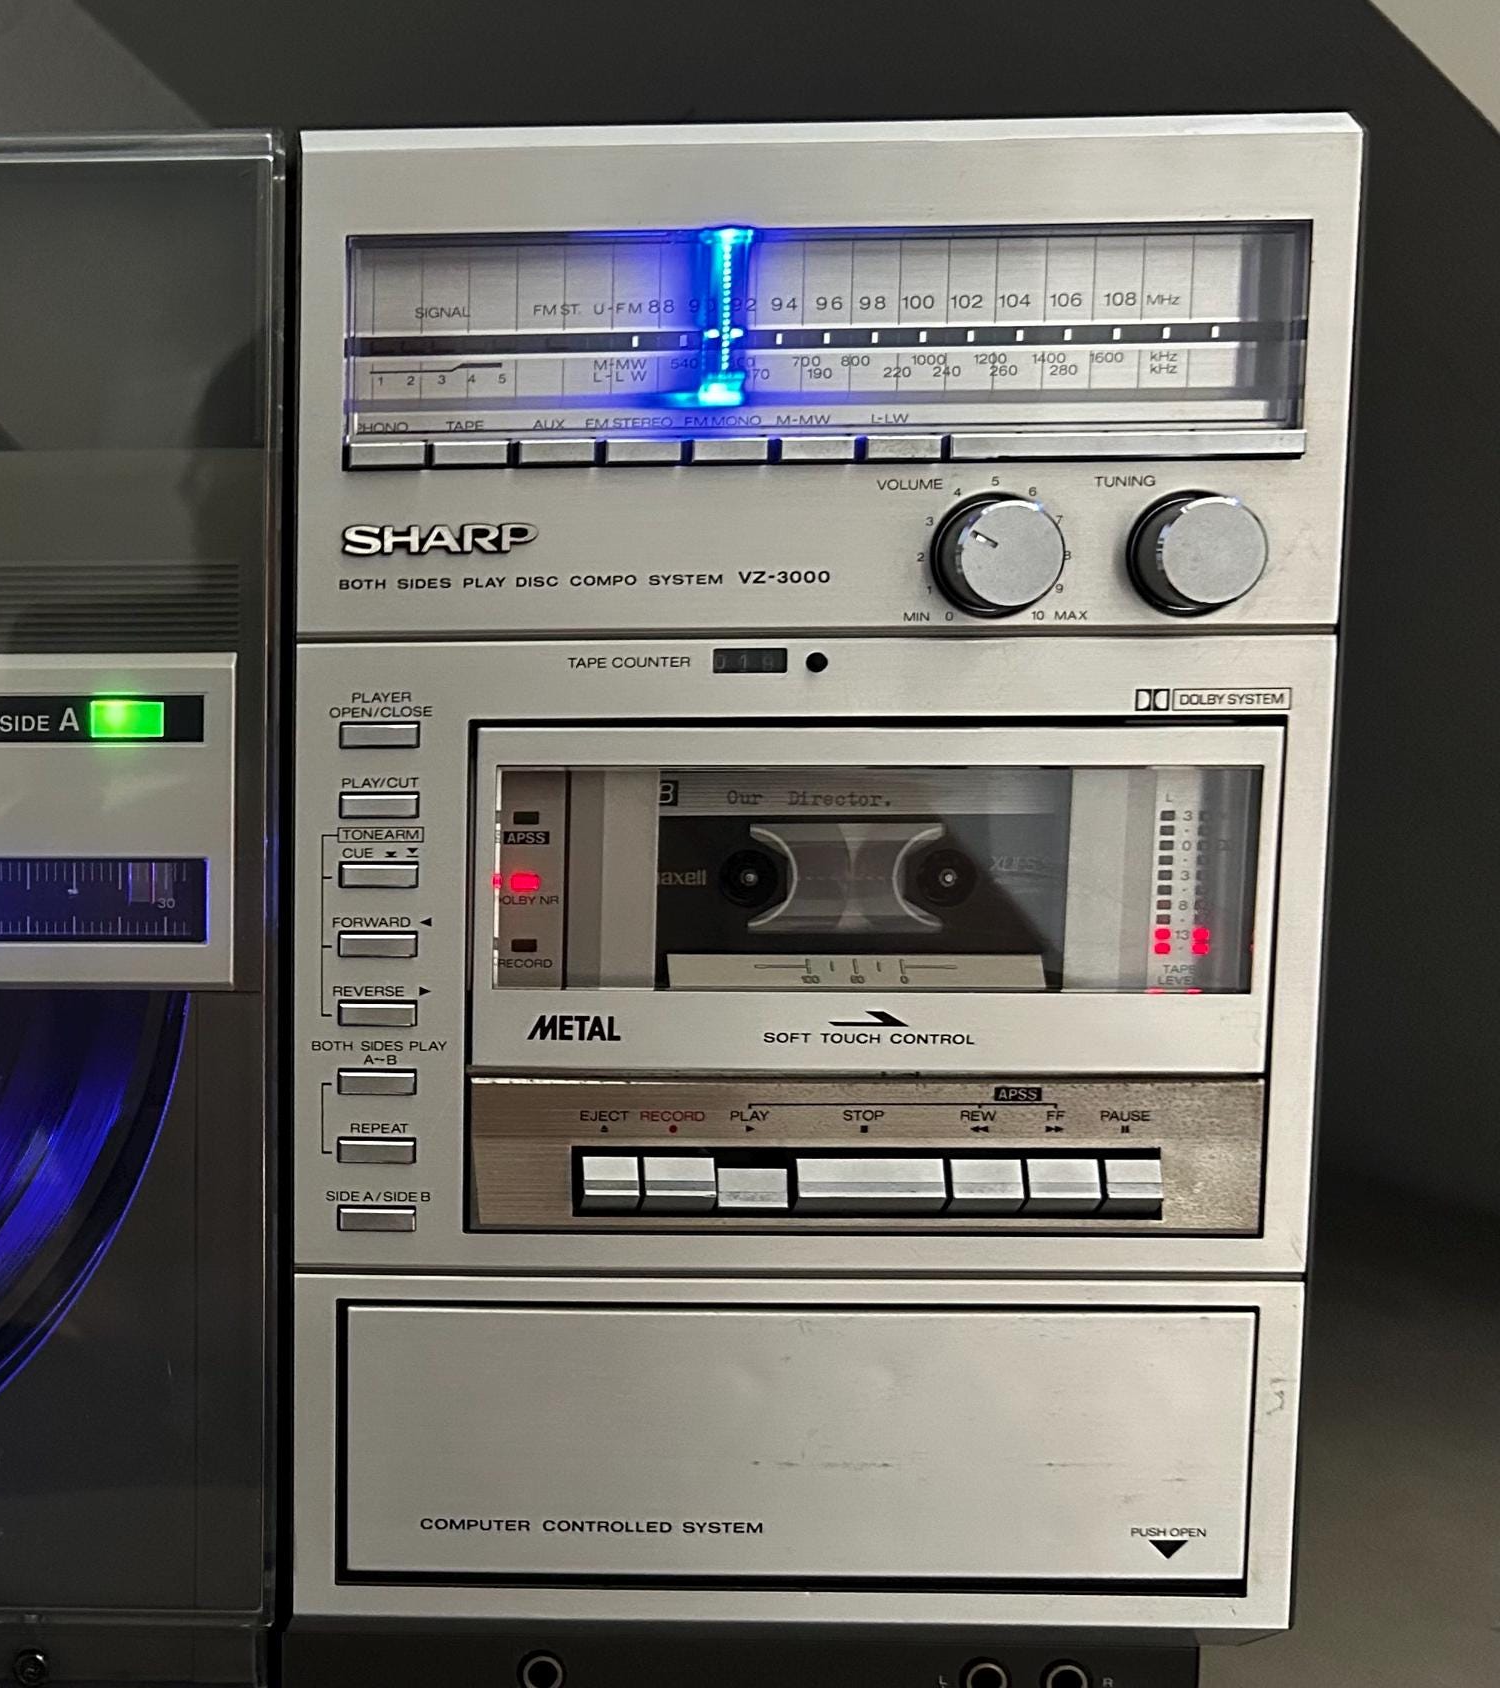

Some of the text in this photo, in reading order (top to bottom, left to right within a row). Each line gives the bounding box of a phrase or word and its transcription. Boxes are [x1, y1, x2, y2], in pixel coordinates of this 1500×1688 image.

[731, 298, 756, 312] 92
[771, 297, 798, 311] 94
[816, 295, 843, 311] 96
[859, 295, 886, 310] 98
[902, 294, 934, 309] 100
[951, 294, 983, 309] 102
[999, 294, 1031, 308] 104
[1050, 292, 1082, 308] 106
[1103, 292, 1136, 307] 108
[1147, 295, 1180, 305] MHz
[415, 306, 470, 319] SIGNAL
[533, 304, 557, 316] FM
[594, 303, 642, 314] U-FM
[649, 300, 675, 314] 88
[792, 356, 821, 366] 700
[841, 355, 870, 367] 800
[913, 355, 947, 366] 1000
[974, 353, 1007, 365] 1200
[1033, 353, 1066, 364] 1400
[1090, 352, 1124, 363] 1600
[1150, 352, 1178, 362] kHz
[594, 360, 646, 370] M-MW
[670, 359, 698, 369] 540
[1150, 364, 1178, 374] kHz
[808, 369, 833, 379] 190
[883, 366, 911, 378] 220
[933, 366, 961, 377] 240
[990, 365, 1018, 377] 260
[1050, 365, 1078, 376] 280
[378, 375, 506, 386] 1 2 3 4 5
[586, 416, 673, 429] FM STEREO
[685, 415, 761, 426] FM MONO
[776, 415, 830, 425] M-MW
[871, 413, 908, 424] L-LW
[358, 422, 409, 433] PHONO
[446, 421, 484, 431] TAPE
[533, 419, 565, 430] AUX
[876, 478, 943, 491] VOLUME
[991, 476, 1000, 486] 5
[1094, 476, 1156, 488] TUNING
[953, 488, 962, 497] 4
[1029, 487, 1037, 497] 6
[926, 517, 934, 526] 3
[1056, 515, 1064, 525] 7
[342, 522, 539, 555] SHARP
[916, 553, 925, 562] 2
[339, 570, 831, 591] BOTH SIDES PLAY DISC COMPO SYSTEM VZ-3000
[927, 586, 932, 595] 1
[1055, 584, 1064, 594] 9
[903, 612, 930, 622] MIN
[945, 612, 954, 622] 0
[1032, 611, 1088, 621] 10 MAX
[568, 657, 690, 668] TAPE COUNTER
[352, 692, 412, 703] PLAYER
[1180, 694, 1284, 705] DOLBY SYSTEM
[329, 706, 433, 718] OPEN/CLOSE
[0, 707, 80, 732] SIDE A
[342, 777, 419, 789] PLAY/CUT
[727, 790, 891, 807] Our Director.
[1183, 811, 1192, 821] 3
[342, 829, 419, 841] TONEARM
[507, 833, 546, 843] APSS
[1182, 841, 1191, 851] 0
[342, 848, 373, 859] CUE
[657, 869, 707, 885] axell
[1181, 871, 1190, 880] 3
[158, 898, 175, 909] 30
[540, 896, 559, 905] NR
[1179, 900, 1188, 910] 8
[332, 917, 411, 928] FORWARD
[1175, 930, 1189, 940] 13
[900, 975, 909, 984] 0
[332, 986, 404, 997] REVERSE
[527, 1015, 621, 1041] METAL
[763, 1032, 975, 1045] SOFT TOUCH CONTROL
[311, 1041, 447, 1052] BOTH SIDES PLAY
[998, 1089, 1038, 1100] APSS
[580, 1110, 629, 1122] EJECT
[640, 1110, 705, 1122] RECORD
[730, 1110, 769, 1122] PLAY
[843, 1110, 885, 1121] STOP
[960, 1110, 997, 1121] REW
[1046, 1110, 1066, 1121] FF
[1100, 1110, 1151, 1122] PAUSE
[350, 1123, 409, 1134] REPEAT
[326, 1191, 360, 1202] SIDE
[421, 1191, 431, 1202] B
[420, 1518, 763, 1534] COMPUTER CONTROLLED SYSTEM
[1131, 1527, 1207, 1538] PUSH OPEN
[1102, 1677, 1114, 1688] R
